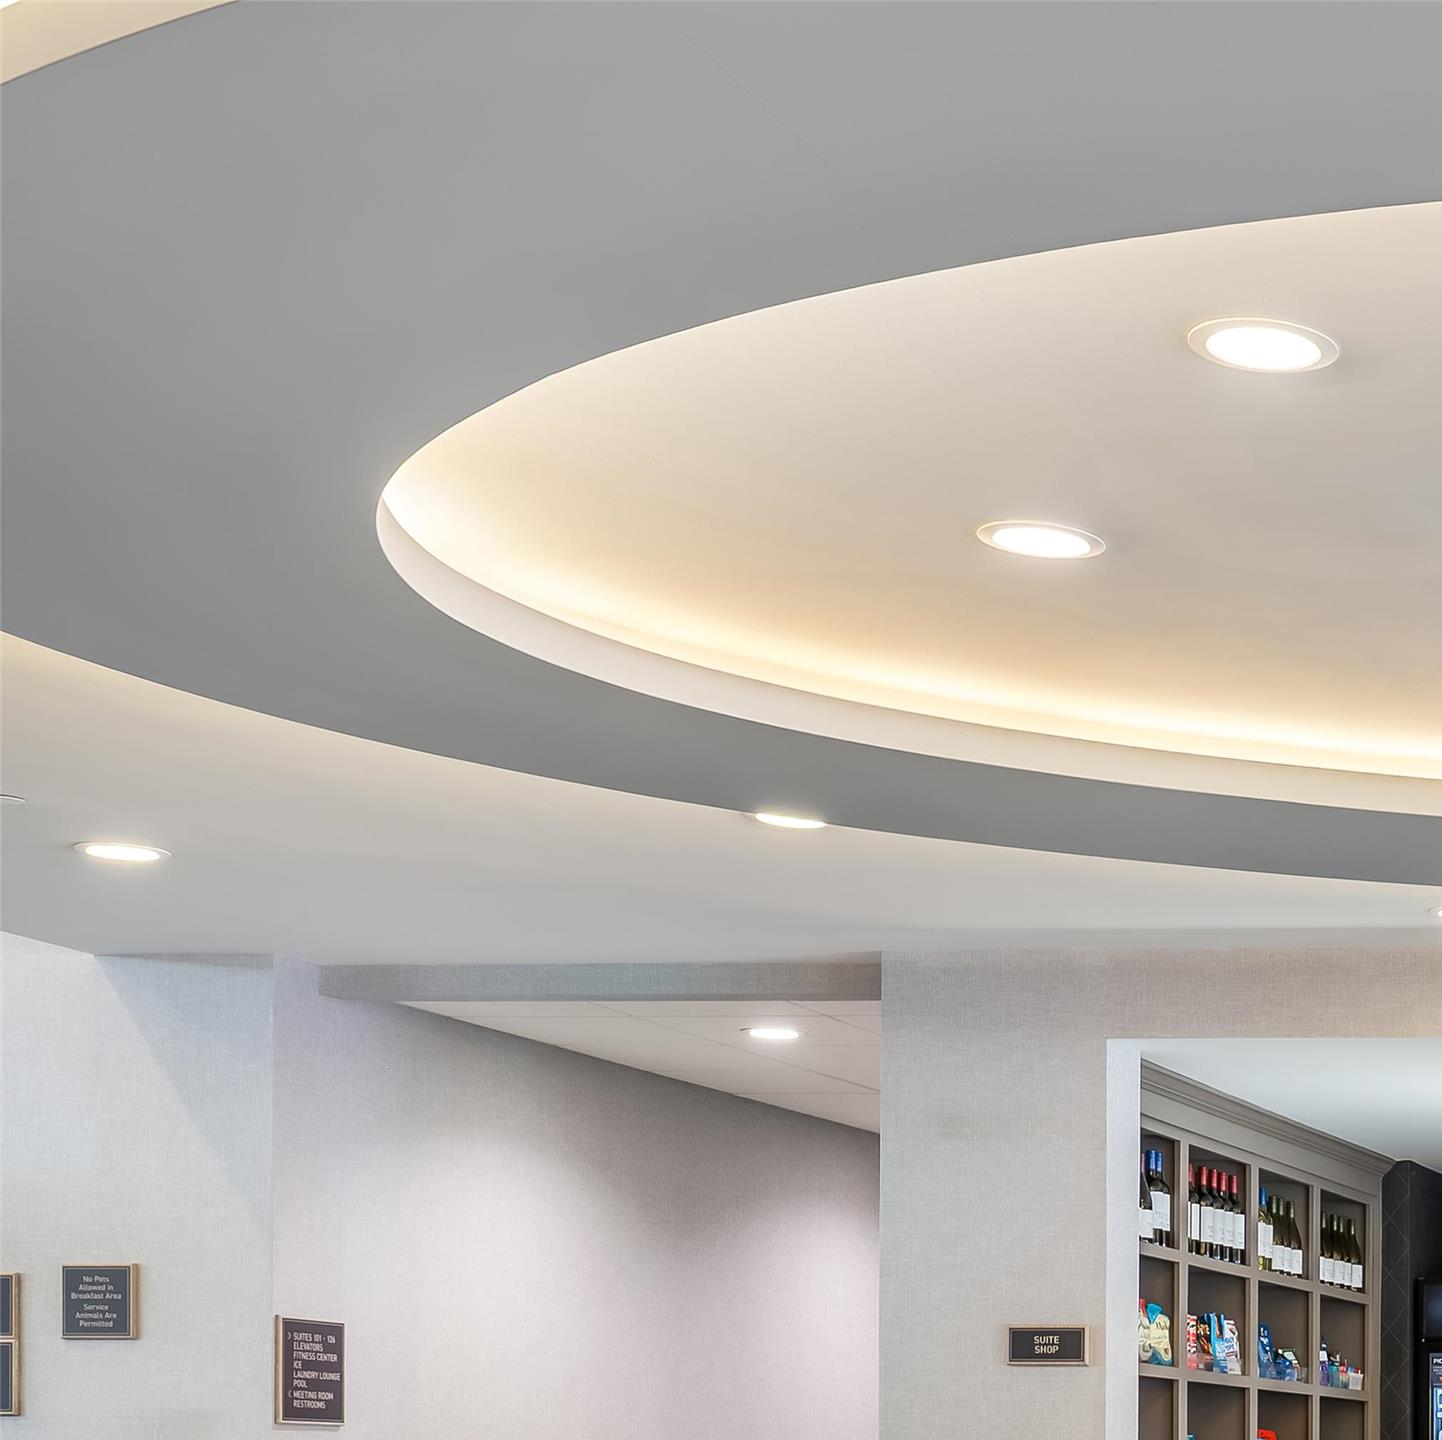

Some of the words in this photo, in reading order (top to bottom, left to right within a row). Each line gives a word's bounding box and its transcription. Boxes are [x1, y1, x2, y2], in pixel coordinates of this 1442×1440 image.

[293, 1332, 312, 1342] SUITES
[1034, 1336, 1060, 1344] SUITE
[293, 1342, 323, 1352] ELEVATORS
[1034, 1345, 1059, 1354] SHOP
[293, 1351, 316, 1360] FITNESS
[317, 1353, 338, 1362] CENTER
[293, 1360, 302, 1369] ICE
[293, 1370, 318, 1379] LAUNDRY
[319, 1372, 341, 1381] LOUNGE
[293, 1380, 308, 1388] POOL
[293, 1390, 317, 1399] MEETING
[318, 1392, 334, 1400] ROOM
[293, 1400, 326, 1409] RESTROOMS
